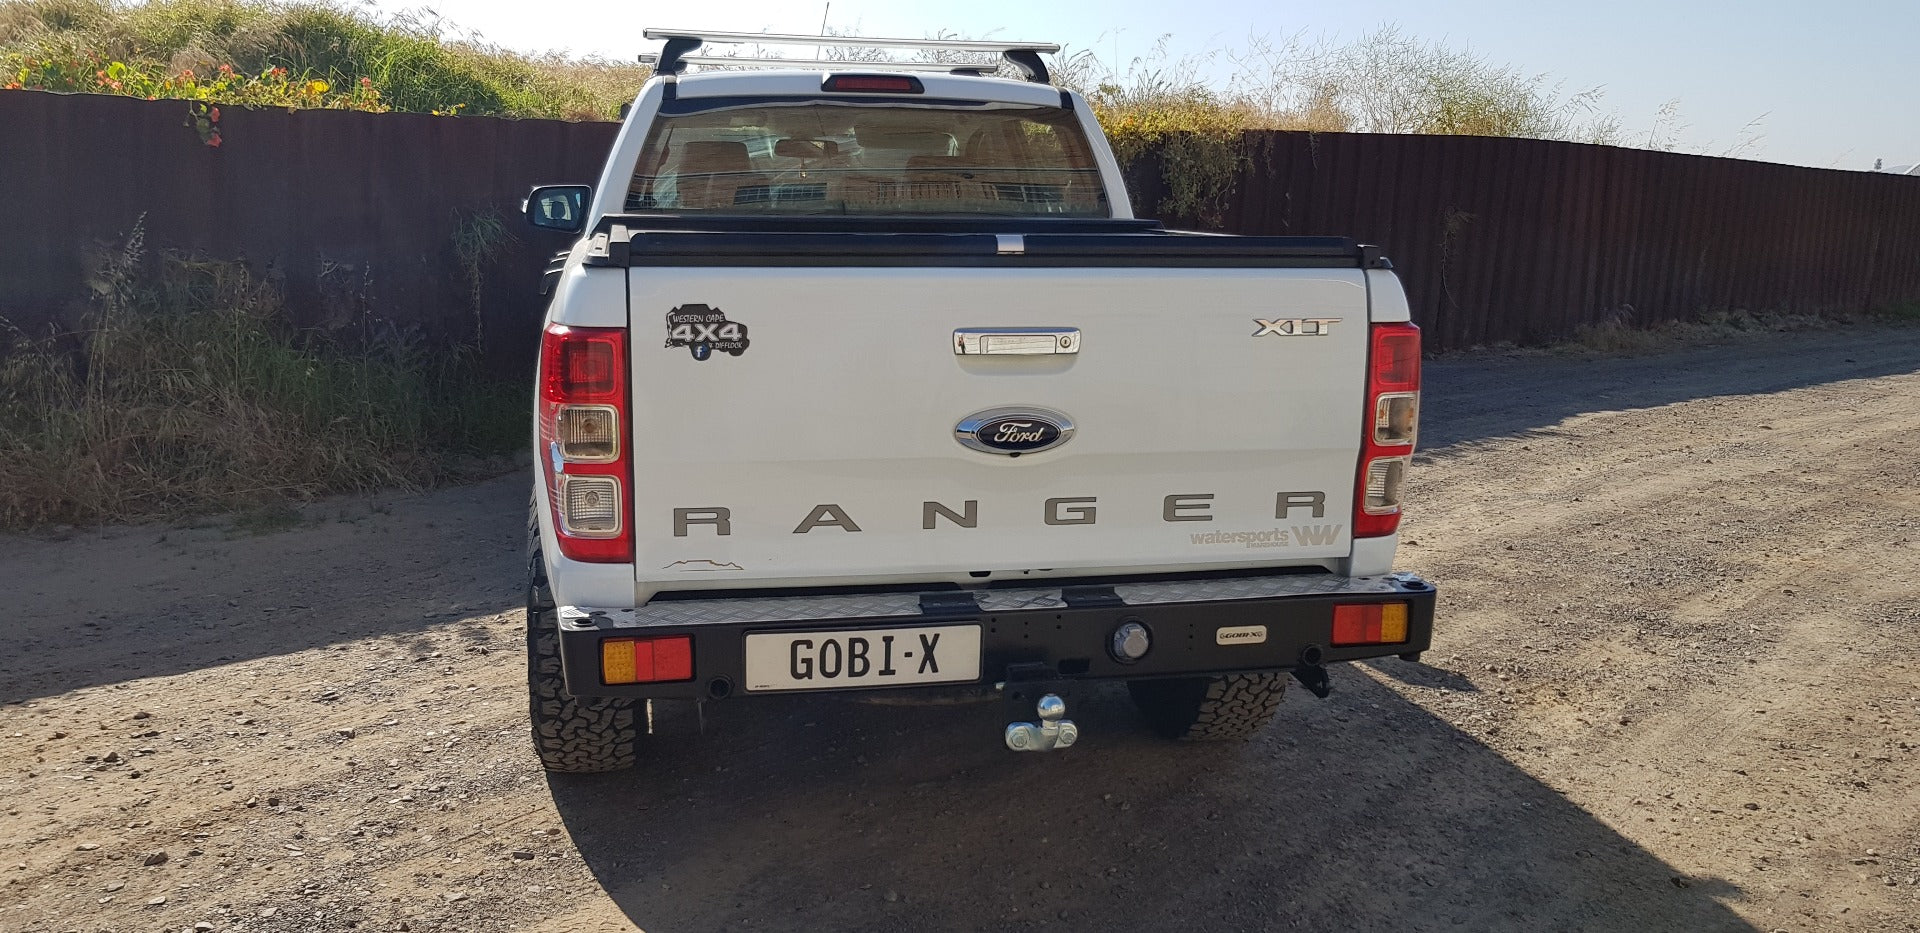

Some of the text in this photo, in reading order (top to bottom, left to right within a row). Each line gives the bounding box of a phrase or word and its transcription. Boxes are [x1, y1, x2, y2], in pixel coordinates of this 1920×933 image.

[673, 313, 725, 323] WESTERN CAPE
[1252, 317, 1342, 337] XLT
[994, 422, 1044, 443] Ford
[674, 490, 1326, 536] RANGER
[1190, 528, 1289, 548] watersports
[791, 633, 941, 680] GOBI-X
